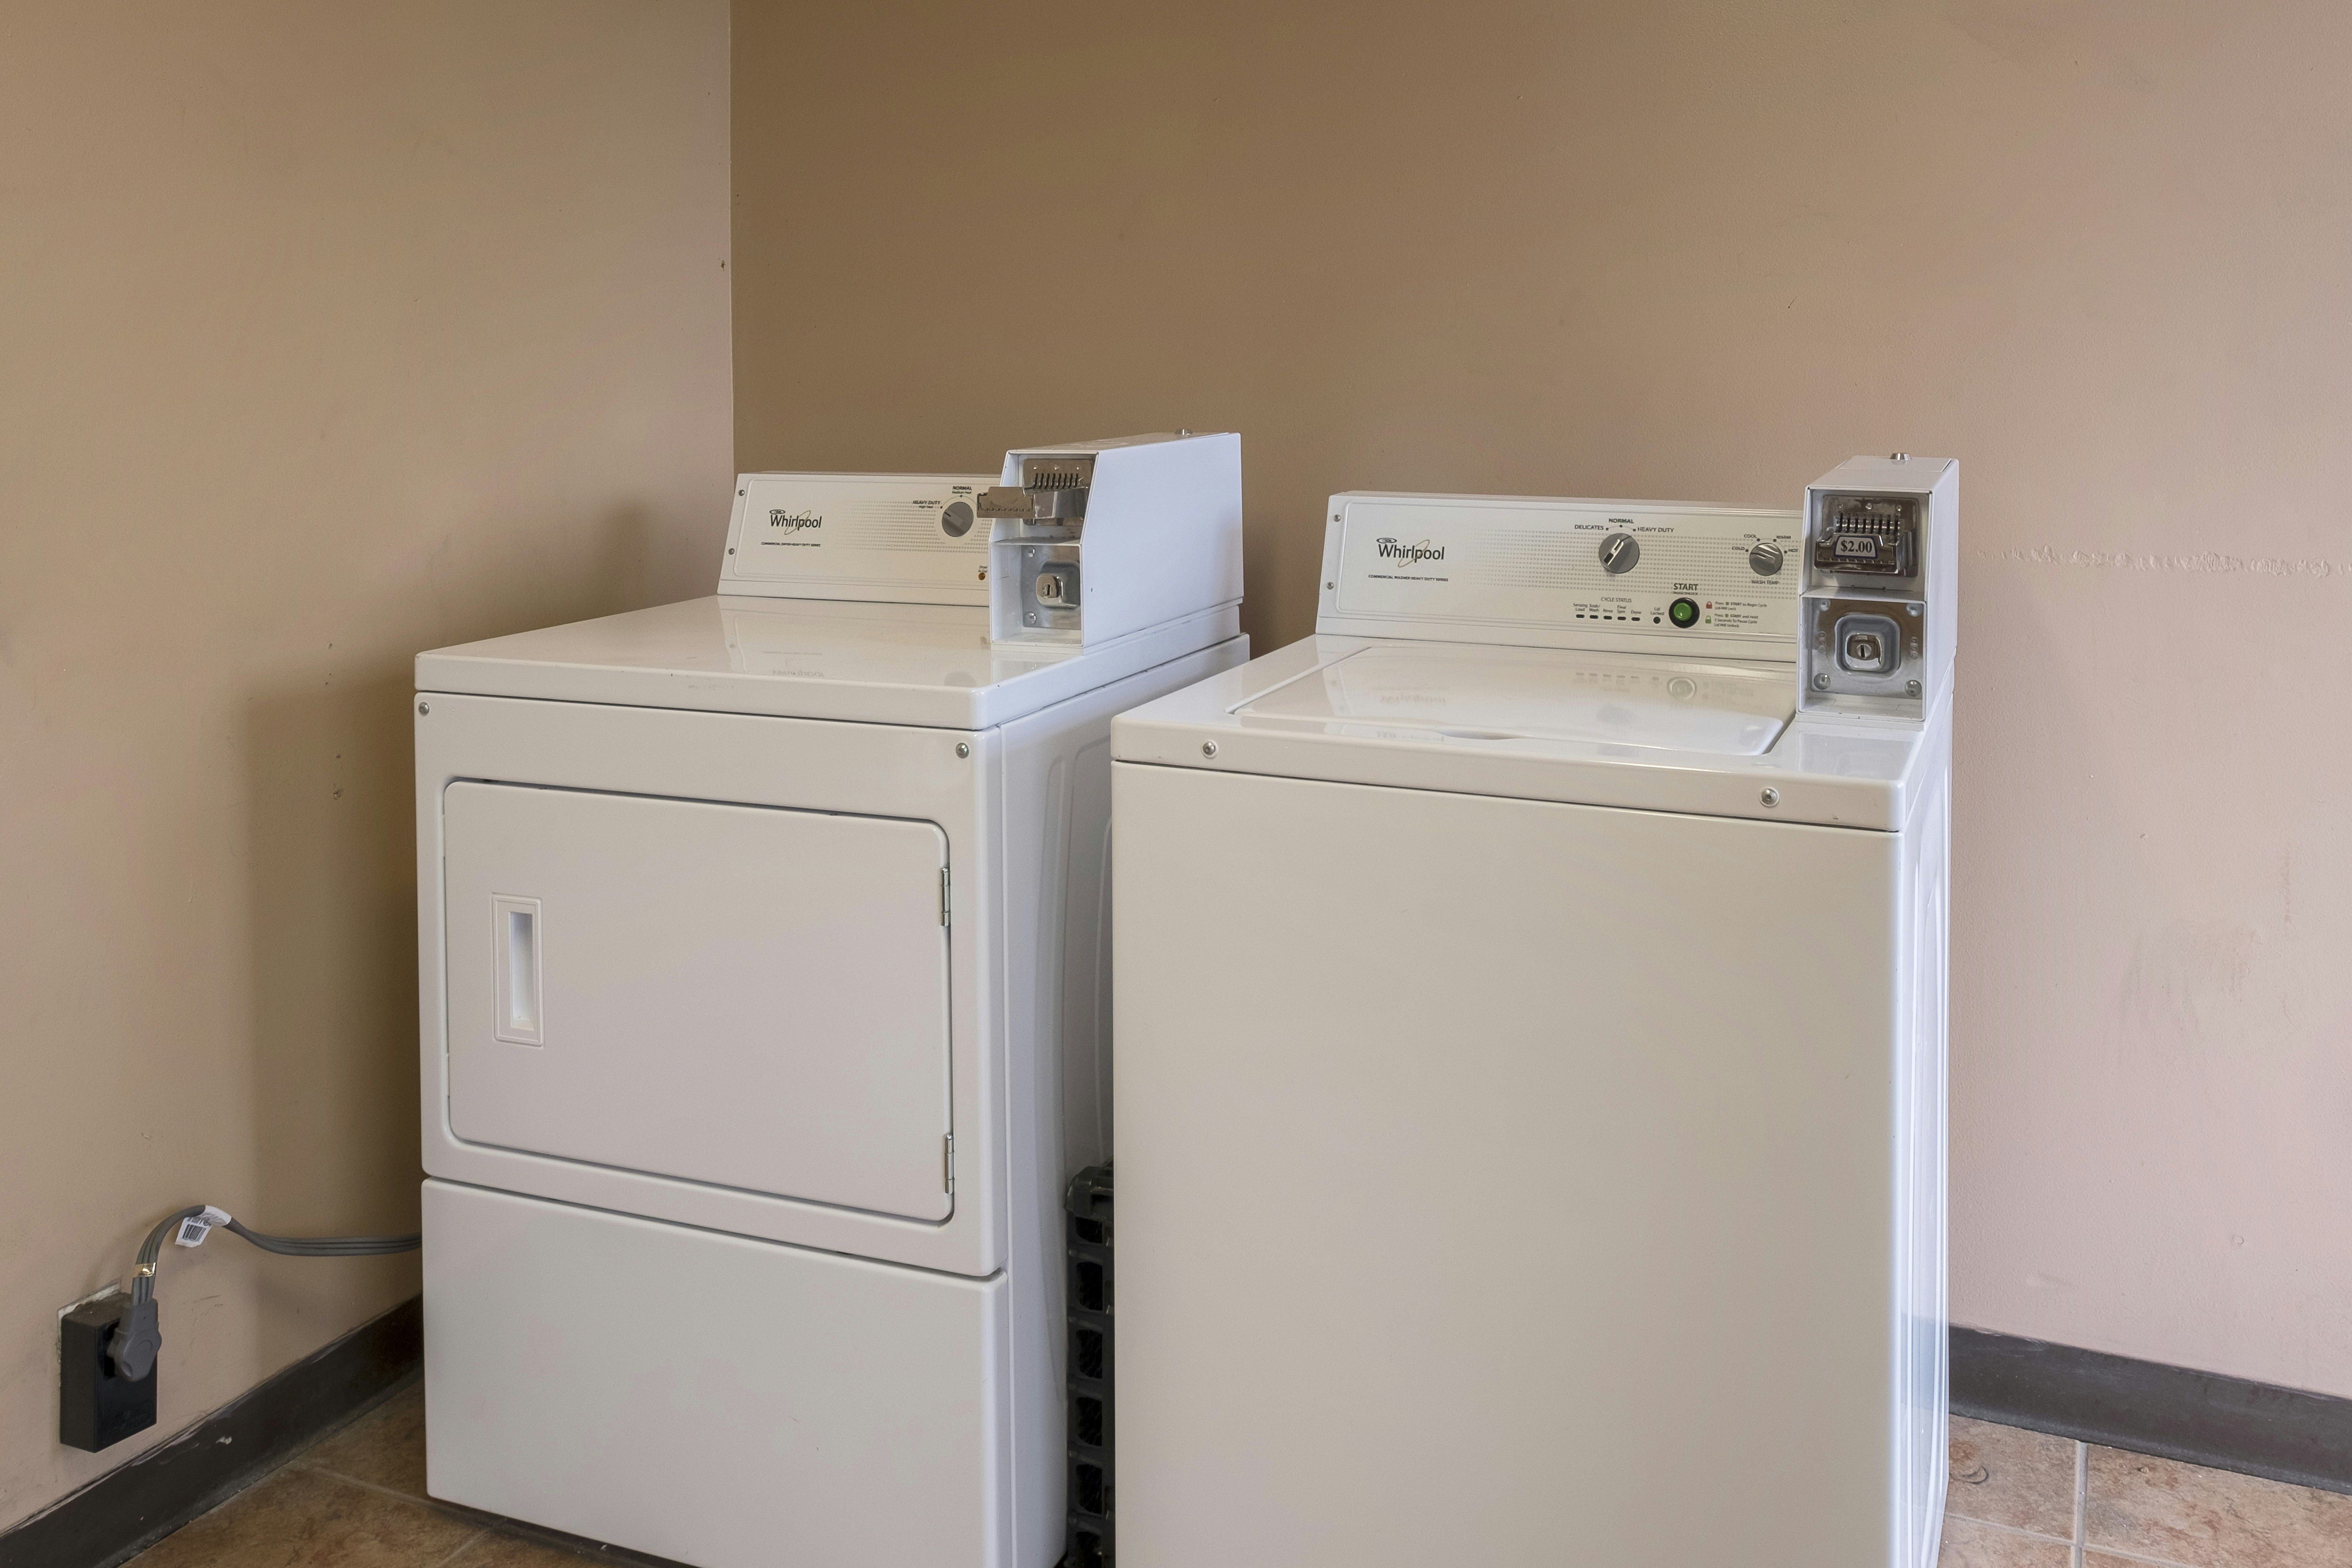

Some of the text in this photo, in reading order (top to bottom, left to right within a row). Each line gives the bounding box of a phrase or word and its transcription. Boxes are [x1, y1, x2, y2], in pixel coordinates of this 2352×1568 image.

[771, 515, 822, 531] Whirlpool
[1378, 543, 1445, 563] Whirlpool
[1841, 539, 1872, 553] $2.00
